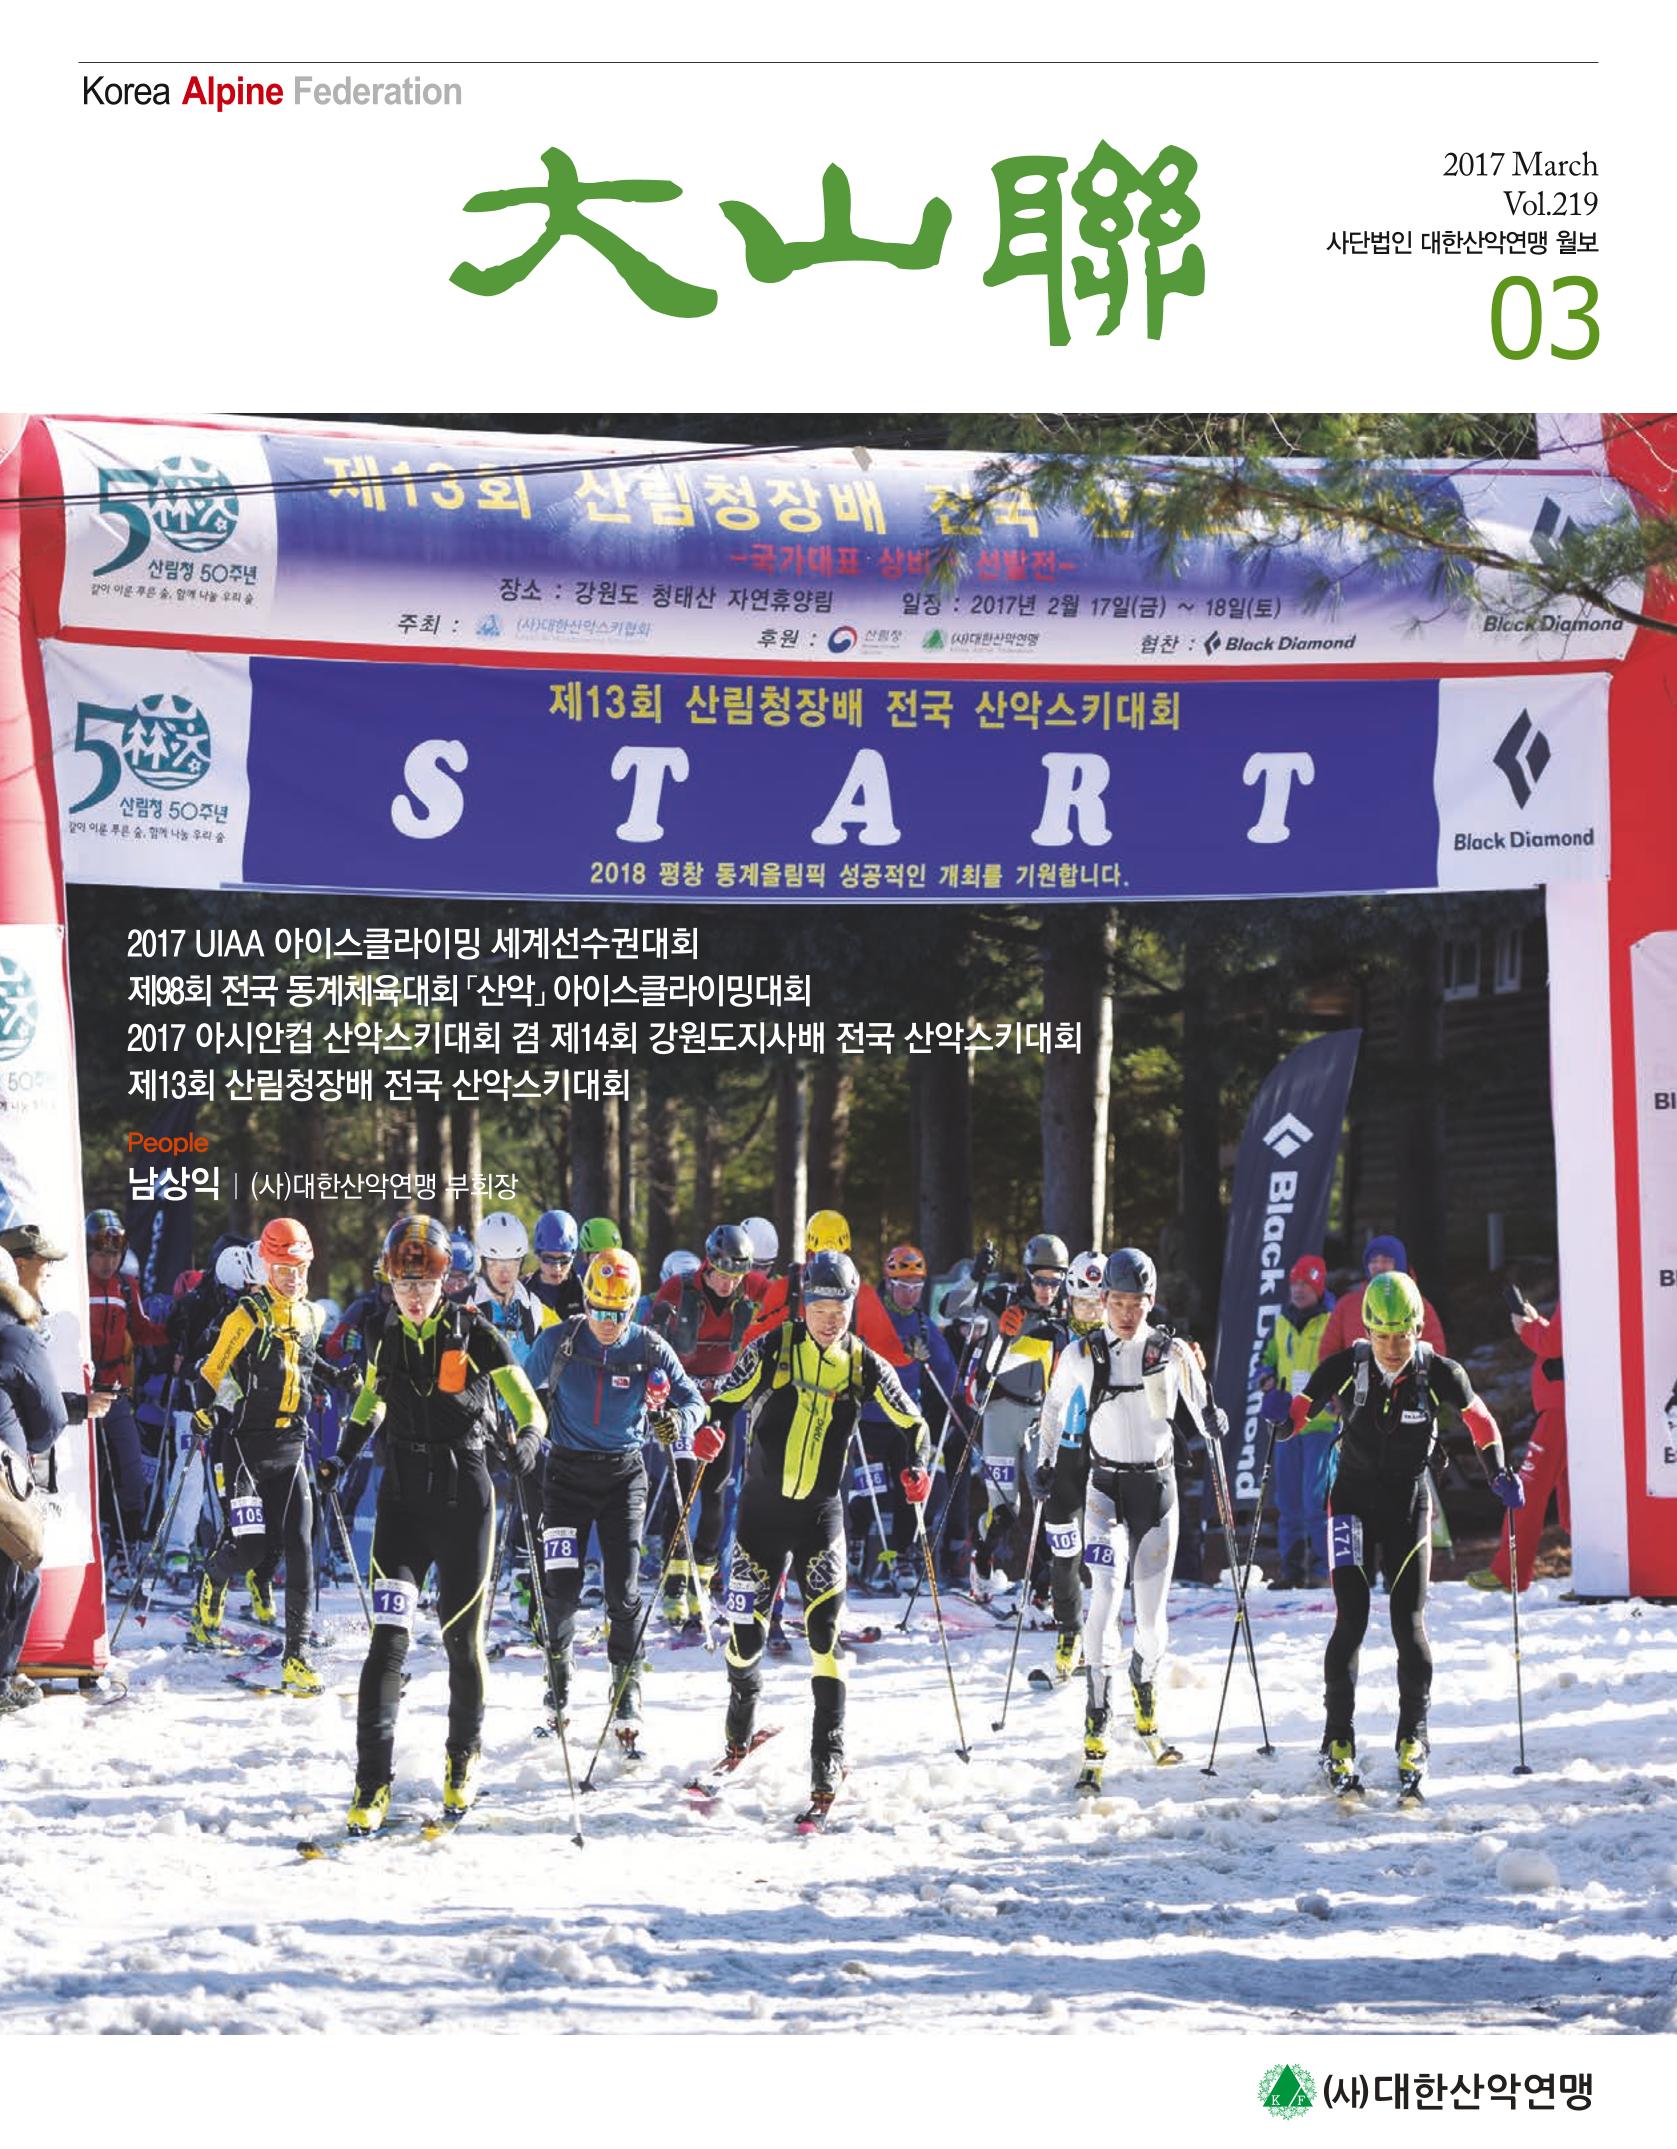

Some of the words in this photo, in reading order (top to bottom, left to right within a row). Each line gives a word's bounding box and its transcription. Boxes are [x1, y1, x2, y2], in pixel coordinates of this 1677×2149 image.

[323, 455, 532, 520] 제13회
[574, 468, 887, 537] 산림청장배
[148, 558, 194, 582] 산림청
[200, 563, 257, 586] 50주년
[499, 577, 543, 601] 장소
[575, 580, 639, 605] 강원도
[653, 584, 716, 610] 청태산
[729, 588, 834, 615] 자연휴양림
[970, 593, 1037, 617] 2017년
[1047, 593, 1080, 618] 2월
[1090, 596, 1167, 620] 17일(금)
[1206, 596, 1282, 620] 18일(토)
[397, 614, 442, 636] 주최
[757, 627, 800, 650] 후원
[1139, 634, 1179, 656] 협찬
[1225, 636, 1274, 652] Black
[1278, 635, 1356, 651] Diamond
[549, 681, 662, 723] 제13회
[685, 684, 863, 727] 산림청장배
[887, 690, 953, 729] 전국
[974, 691, 1180, 730] 산악스키대회
[119, 797, 163, 819] 산림청
[168, 801, 229, 824] 50주년
[1453, 832, 1506, 852] Black
[1510, 828, 1595, 849] Diamond
[590, 862, 646, 884] 2018
[658, 861, 704, 886] 평창
[715, 861, 827, 888] 동계올림픽
[839, 863, 927, 889] 성공적인
[939, 863, 1004, 888] 개최를
[1015, 863, 1130, 888] 기원합니다.
[1260, 1171, 1298, 1295] Black
[988, 1466, 1009, 1481] 61
[236, 1508, 264, 1525] 105
[1334, 1521, 1351, 1557] 171
[380, 1593, 405, 1613] 19
